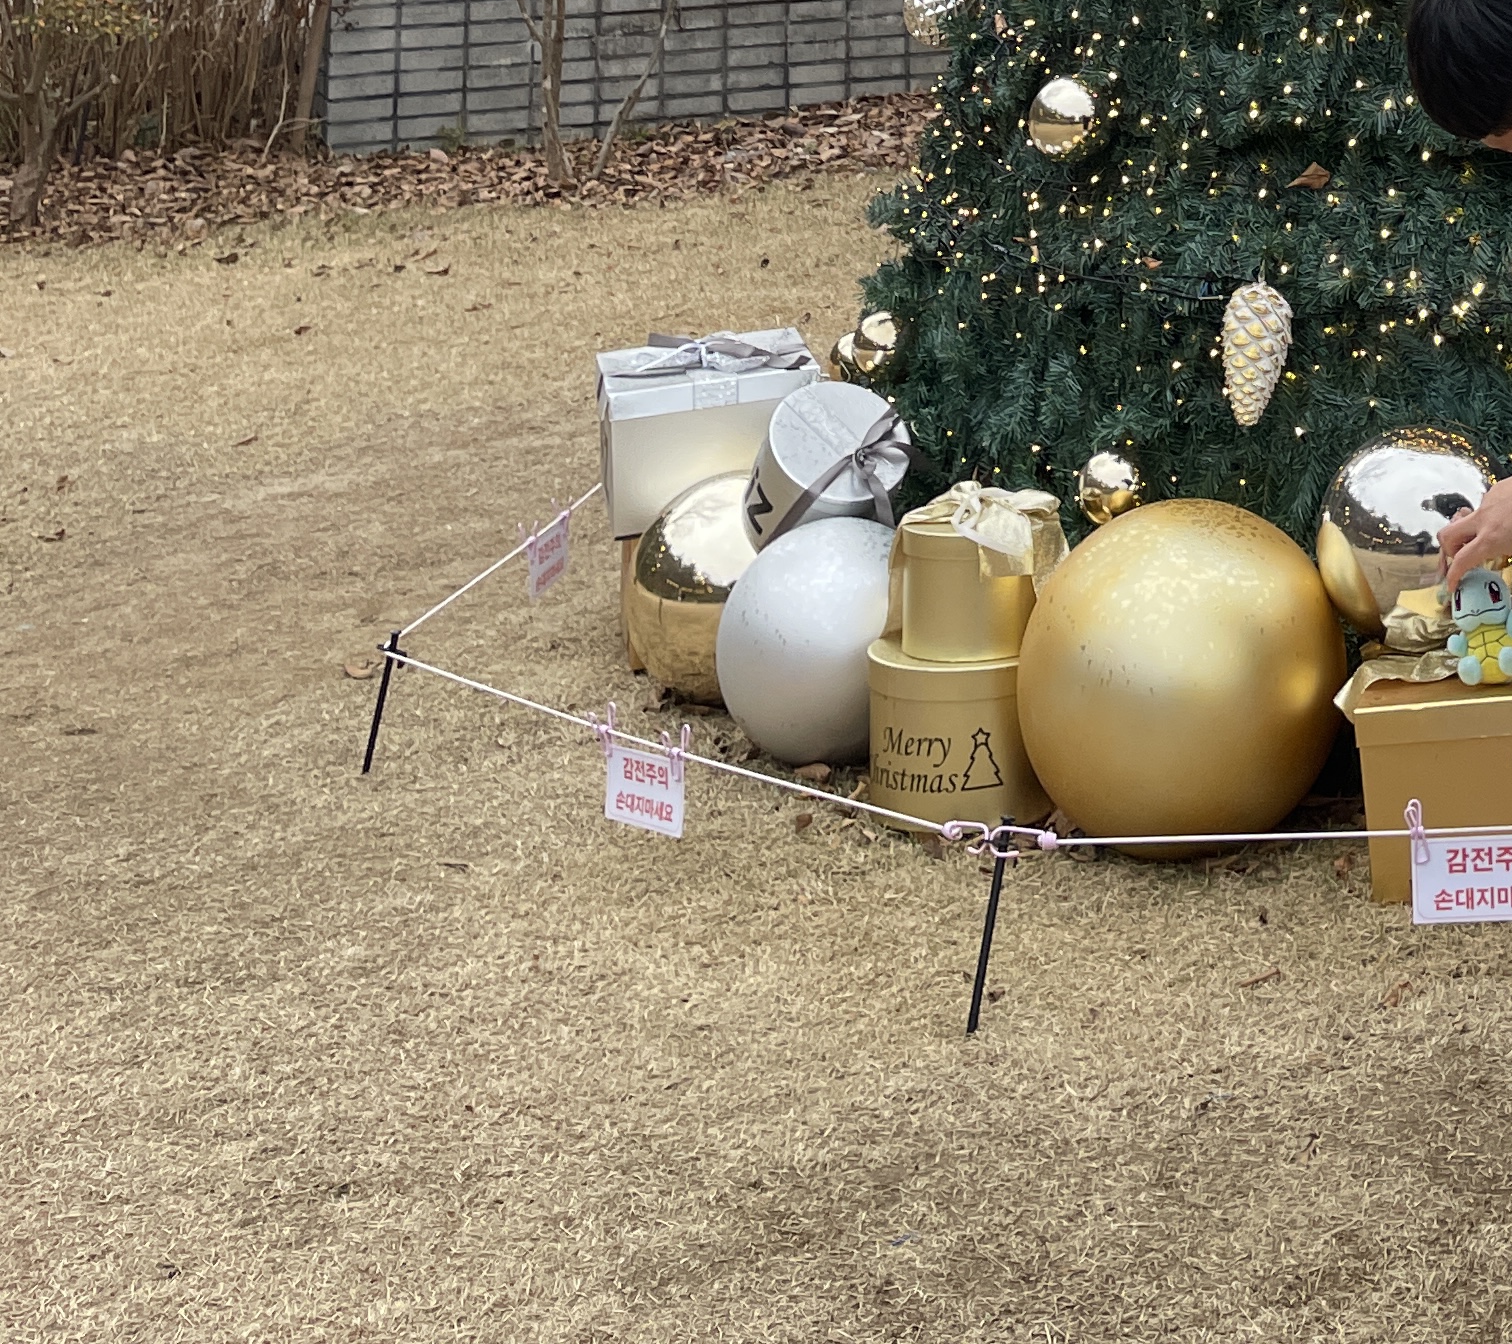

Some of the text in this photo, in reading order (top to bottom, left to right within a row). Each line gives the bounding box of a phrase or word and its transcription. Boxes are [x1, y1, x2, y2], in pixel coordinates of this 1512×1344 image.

[883, 726, 952, 768] Merry
[623, 757, 669, 790] 감전주의
[870, 753, 959, 794] hristmas
[616, 790, 673, 822] 손대지마세요
